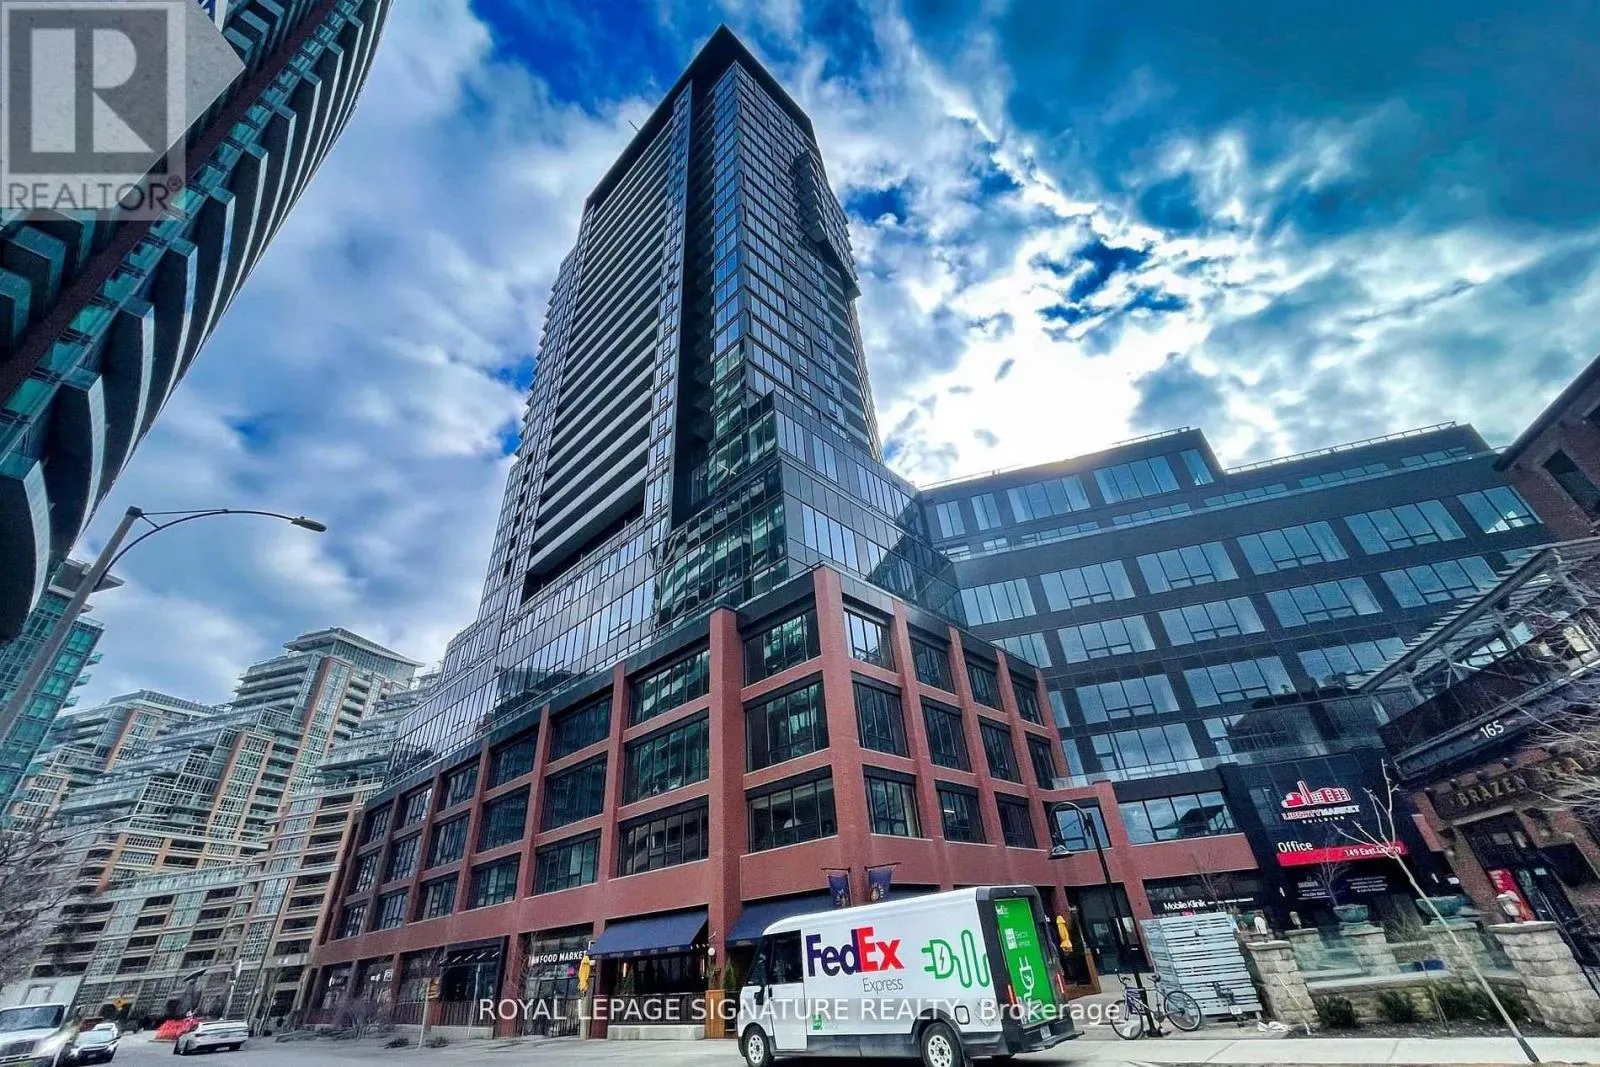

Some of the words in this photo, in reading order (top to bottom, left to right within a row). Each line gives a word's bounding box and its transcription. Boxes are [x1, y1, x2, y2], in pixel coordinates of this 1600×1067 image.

[1480, 720, 1504, 739] 165
[1278, 841, 1314, 853] Office
[1344, 848, 1359, 857] 149
[559, 950, 587, 962] MARKET
[806, 927, 905, 977] FedEx
[862, 977, 904, 995] Express
